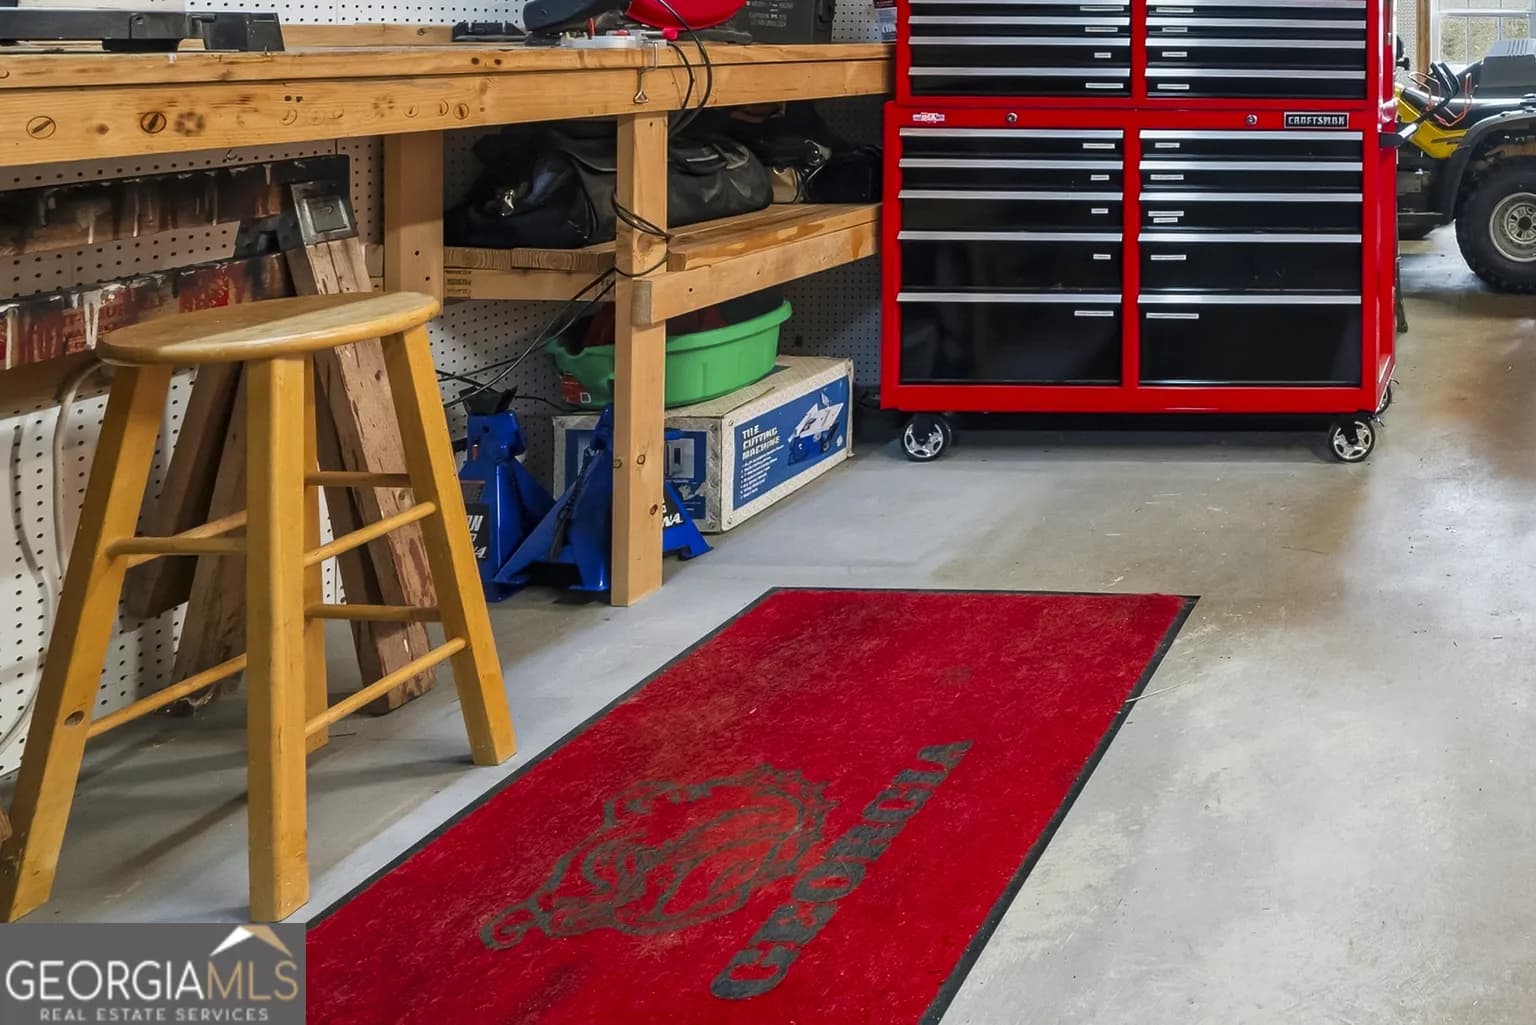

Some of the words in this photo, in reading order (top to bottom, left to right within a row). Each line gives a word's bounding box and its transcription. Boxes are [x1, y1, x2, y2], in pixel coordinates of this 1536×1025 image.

[1288, 116, 1345, 126] CRAFTSMAN
[743, 426, 778, 450] CUTTING
[743, 435, 780, 461] MACHINE
[710, 740, 973, 1000] GEORGIA
